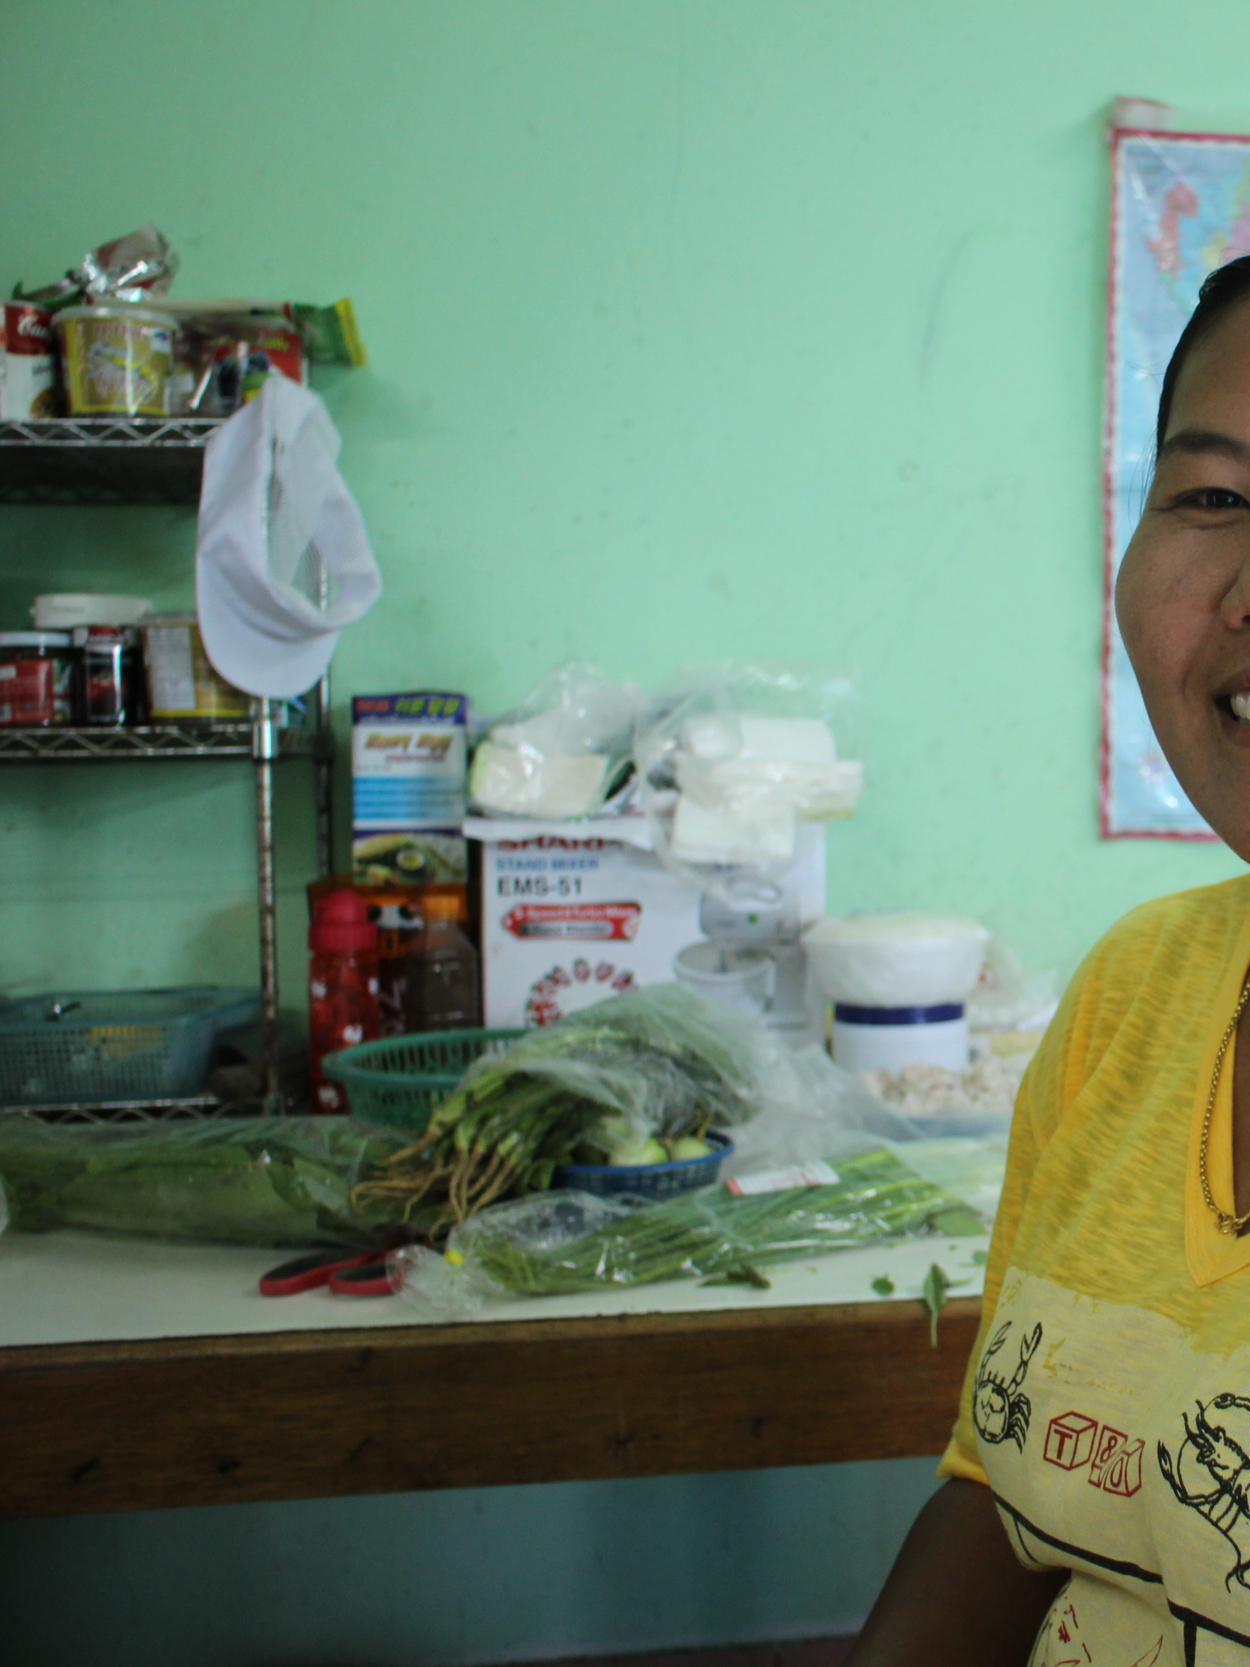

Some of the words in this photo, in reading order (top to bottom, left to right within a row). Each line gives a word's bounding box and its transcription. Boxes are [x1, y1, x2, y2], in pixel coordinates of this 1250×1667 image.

[496, 857, 547, 870] STAND
[551, 857, 599, 870] MIXER
[497, 876, 582, 896] EMS-51
[1053, 1428, 1073, 1460] T
